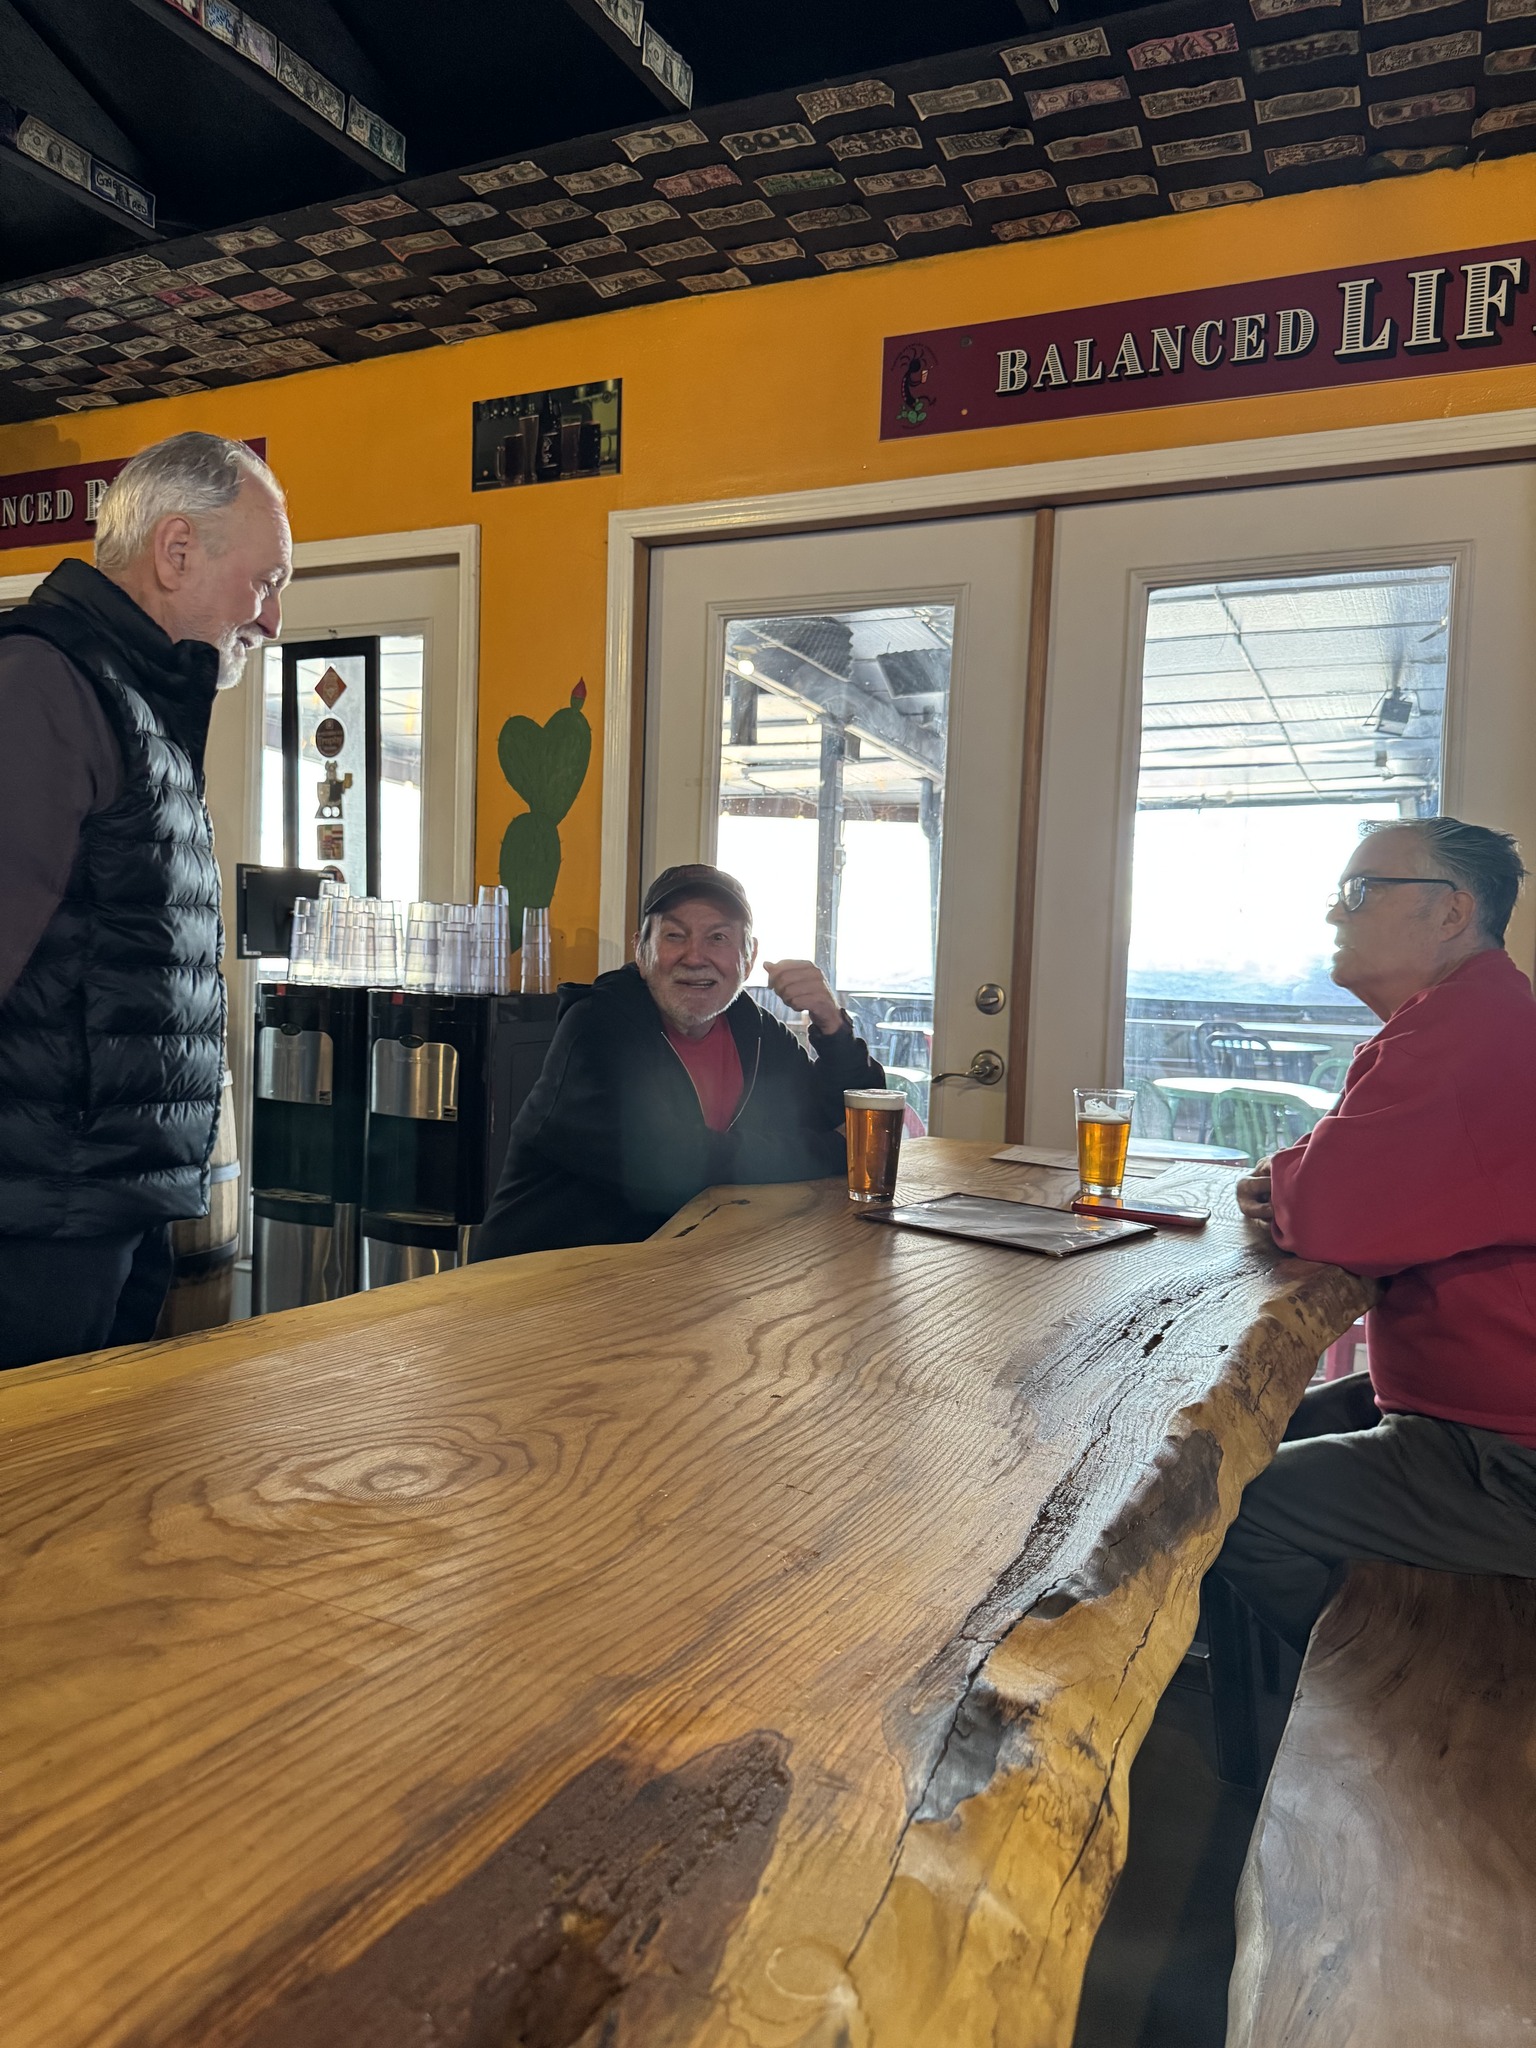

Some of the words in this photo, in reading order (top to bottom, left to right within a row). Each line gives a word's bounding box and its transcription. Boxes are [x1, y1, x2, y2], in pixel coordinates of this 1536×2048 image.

[731, 126, 804, 153] 804
[995, 308, 1316, 394] BALANCED
[1333, 258, 1536, 356] LIF
[1, 489, 74, 527] NCED
